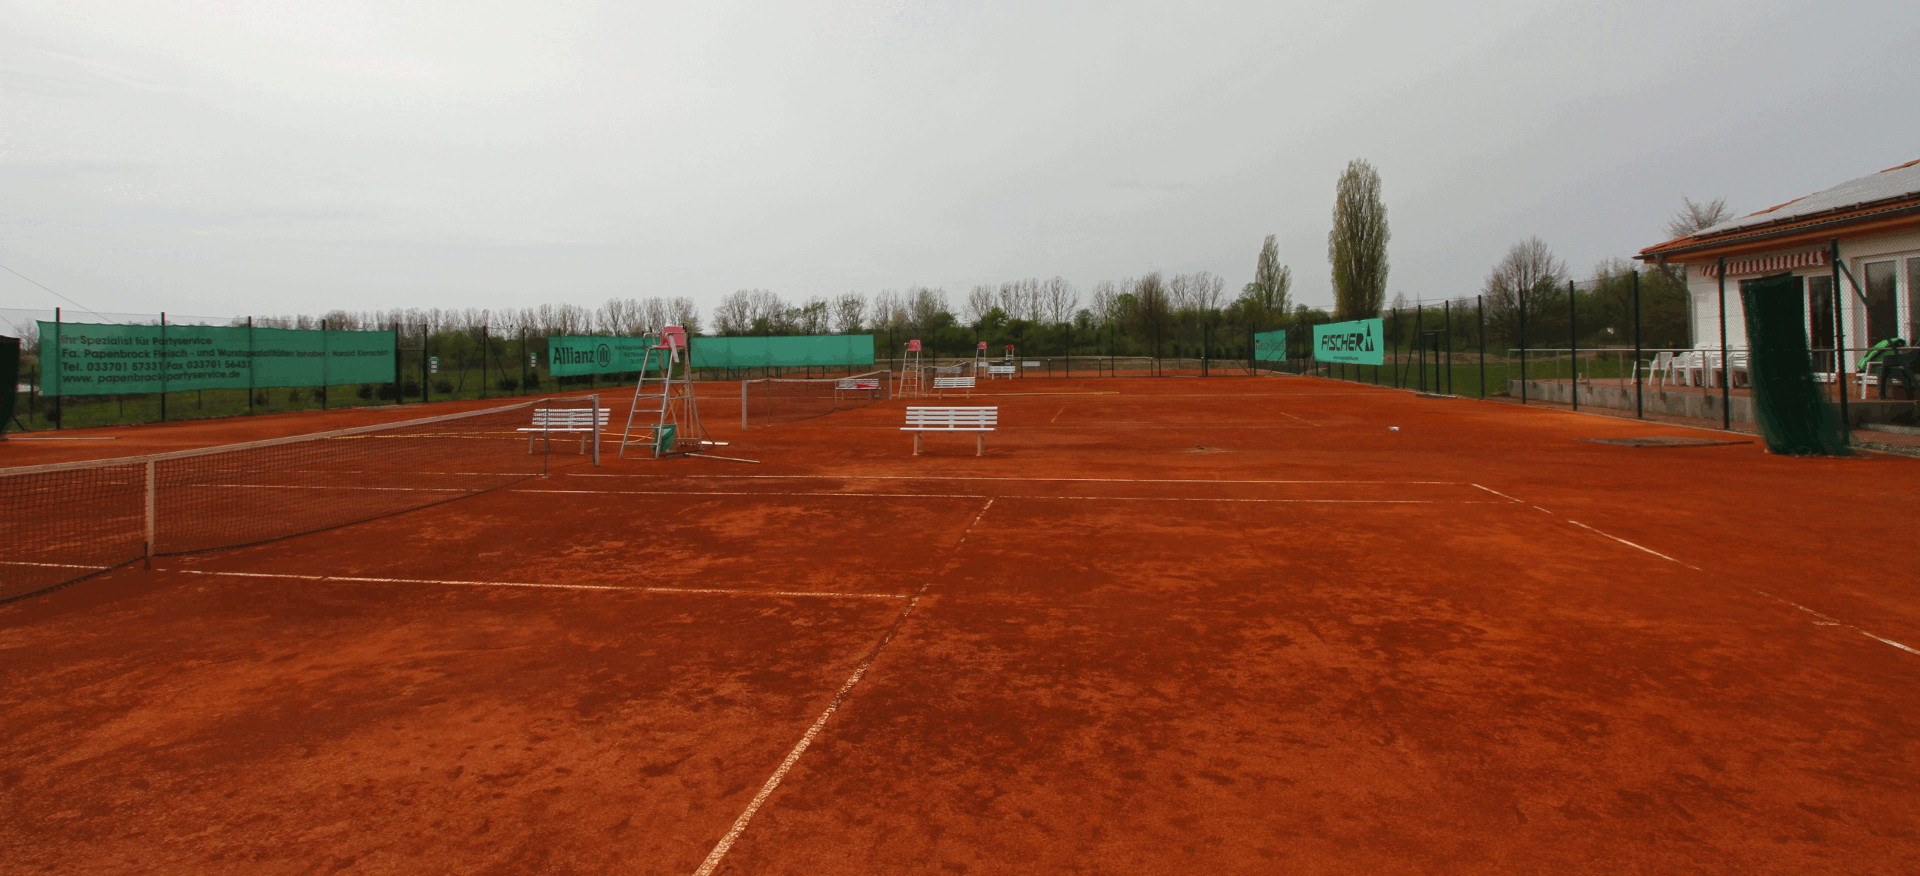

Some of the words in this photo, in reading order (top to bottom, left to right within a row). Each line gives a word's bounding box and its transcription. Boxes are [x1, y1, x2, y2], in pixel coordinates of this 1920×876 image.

[80, 335, 132, 346] Spezialist
[135, 336, 149, 345] für
[152, 337, 212, 346] Partyservice
[1321, 333, 1364, 352] FISCHER
[62, 349, 81, 358] Fa.
[84, 349, 150, 360] Papenbrock
[153, 349, 187, 358] Fleisch
[197, 349, 215, 357] und
[553, 347, 595, 365] Allianz
[63, 362, 83, 371] Tel.
[87, 362, 127, 371] 033701
[167, 362, 183, 370] Fax
[187, 360, 221, 369] 033701
[62, 375, 94, 383] www.
